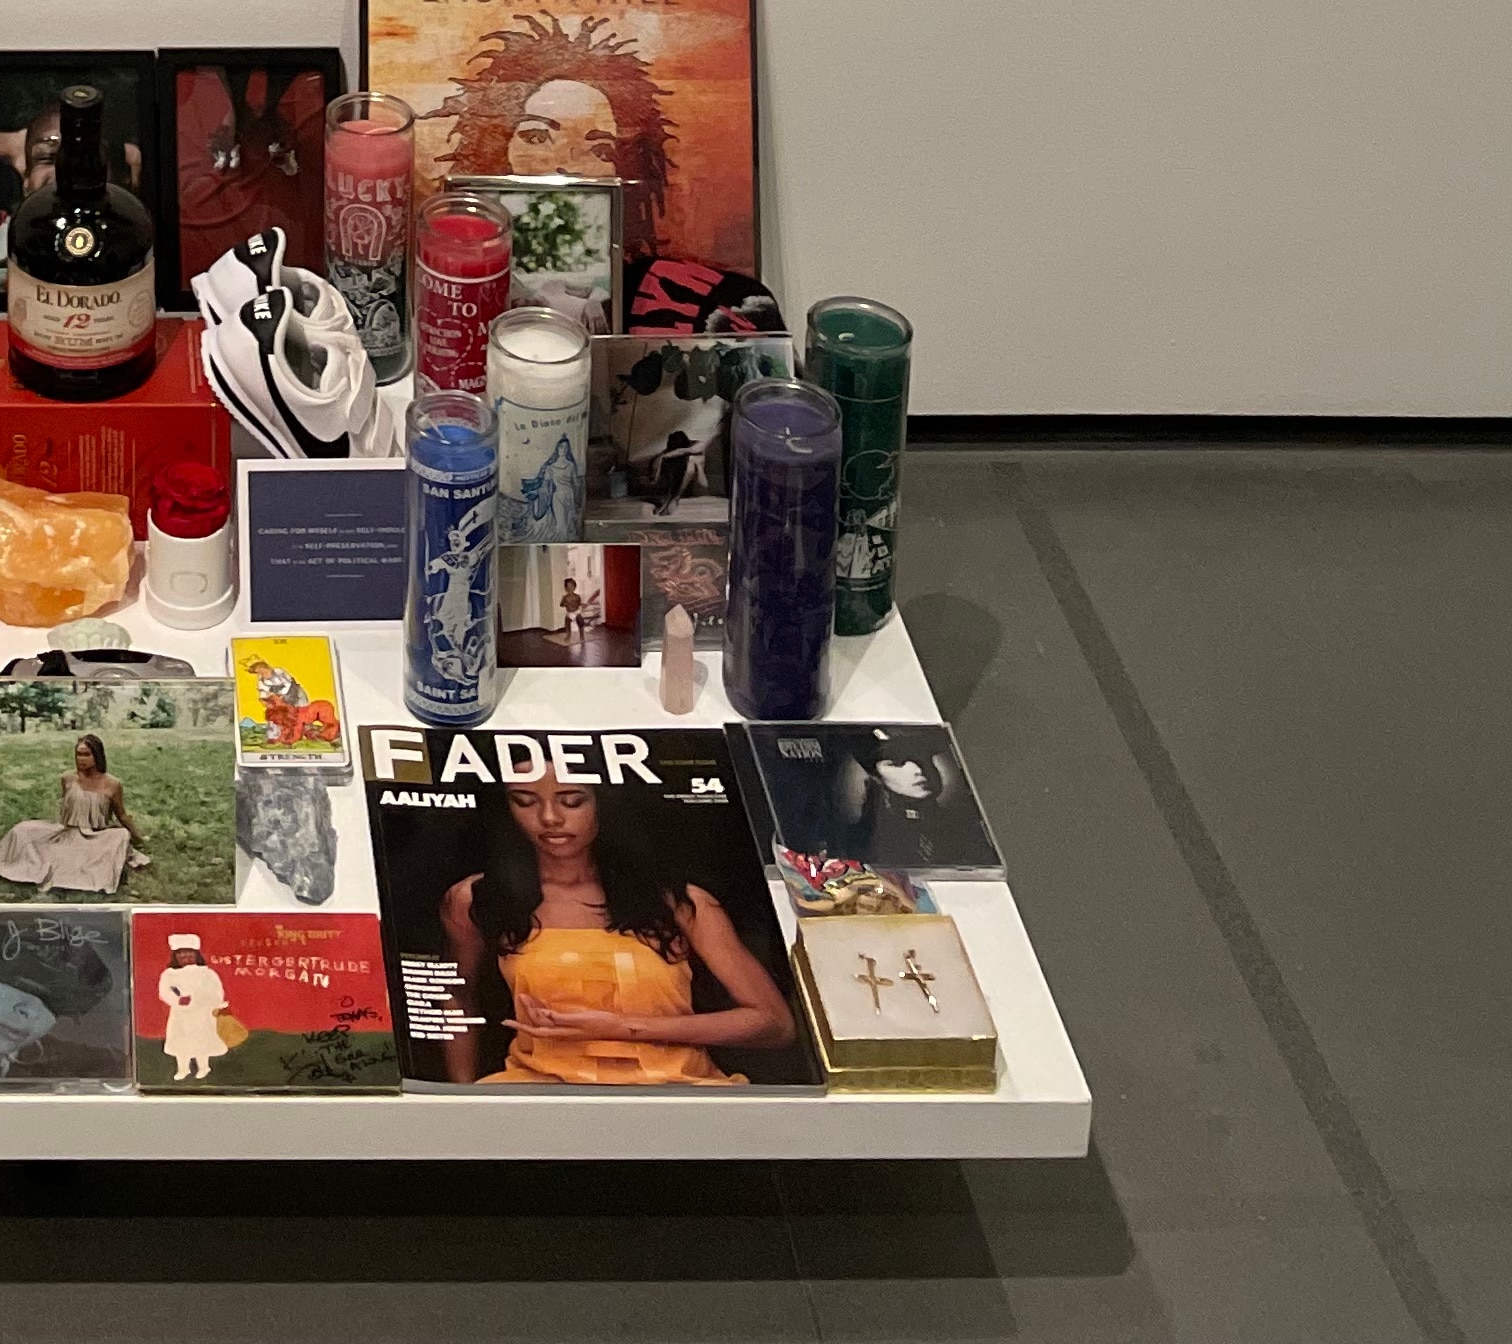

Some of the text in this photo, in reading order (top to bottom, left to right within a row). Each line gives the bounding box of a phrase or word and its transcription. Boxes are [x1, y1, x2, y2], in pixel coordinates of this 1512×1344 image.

[327, 170, 408, 202] LUCKY
[420, 273, 463, 300] OME
[57, 290, 122, 310] DORADO
[448, 300, 478, 318] TO
[422, 482, 450, 500] SAN
[416, 680, 456, 701] SAINT
[369, 727, 663, 786] FADER
[691, 777, 726, 794] 54
[379, 789, 477, 809] AALIYAH
[33, 917, 110, 948] Blige
[234, 967, 331, 989] MORGAN
